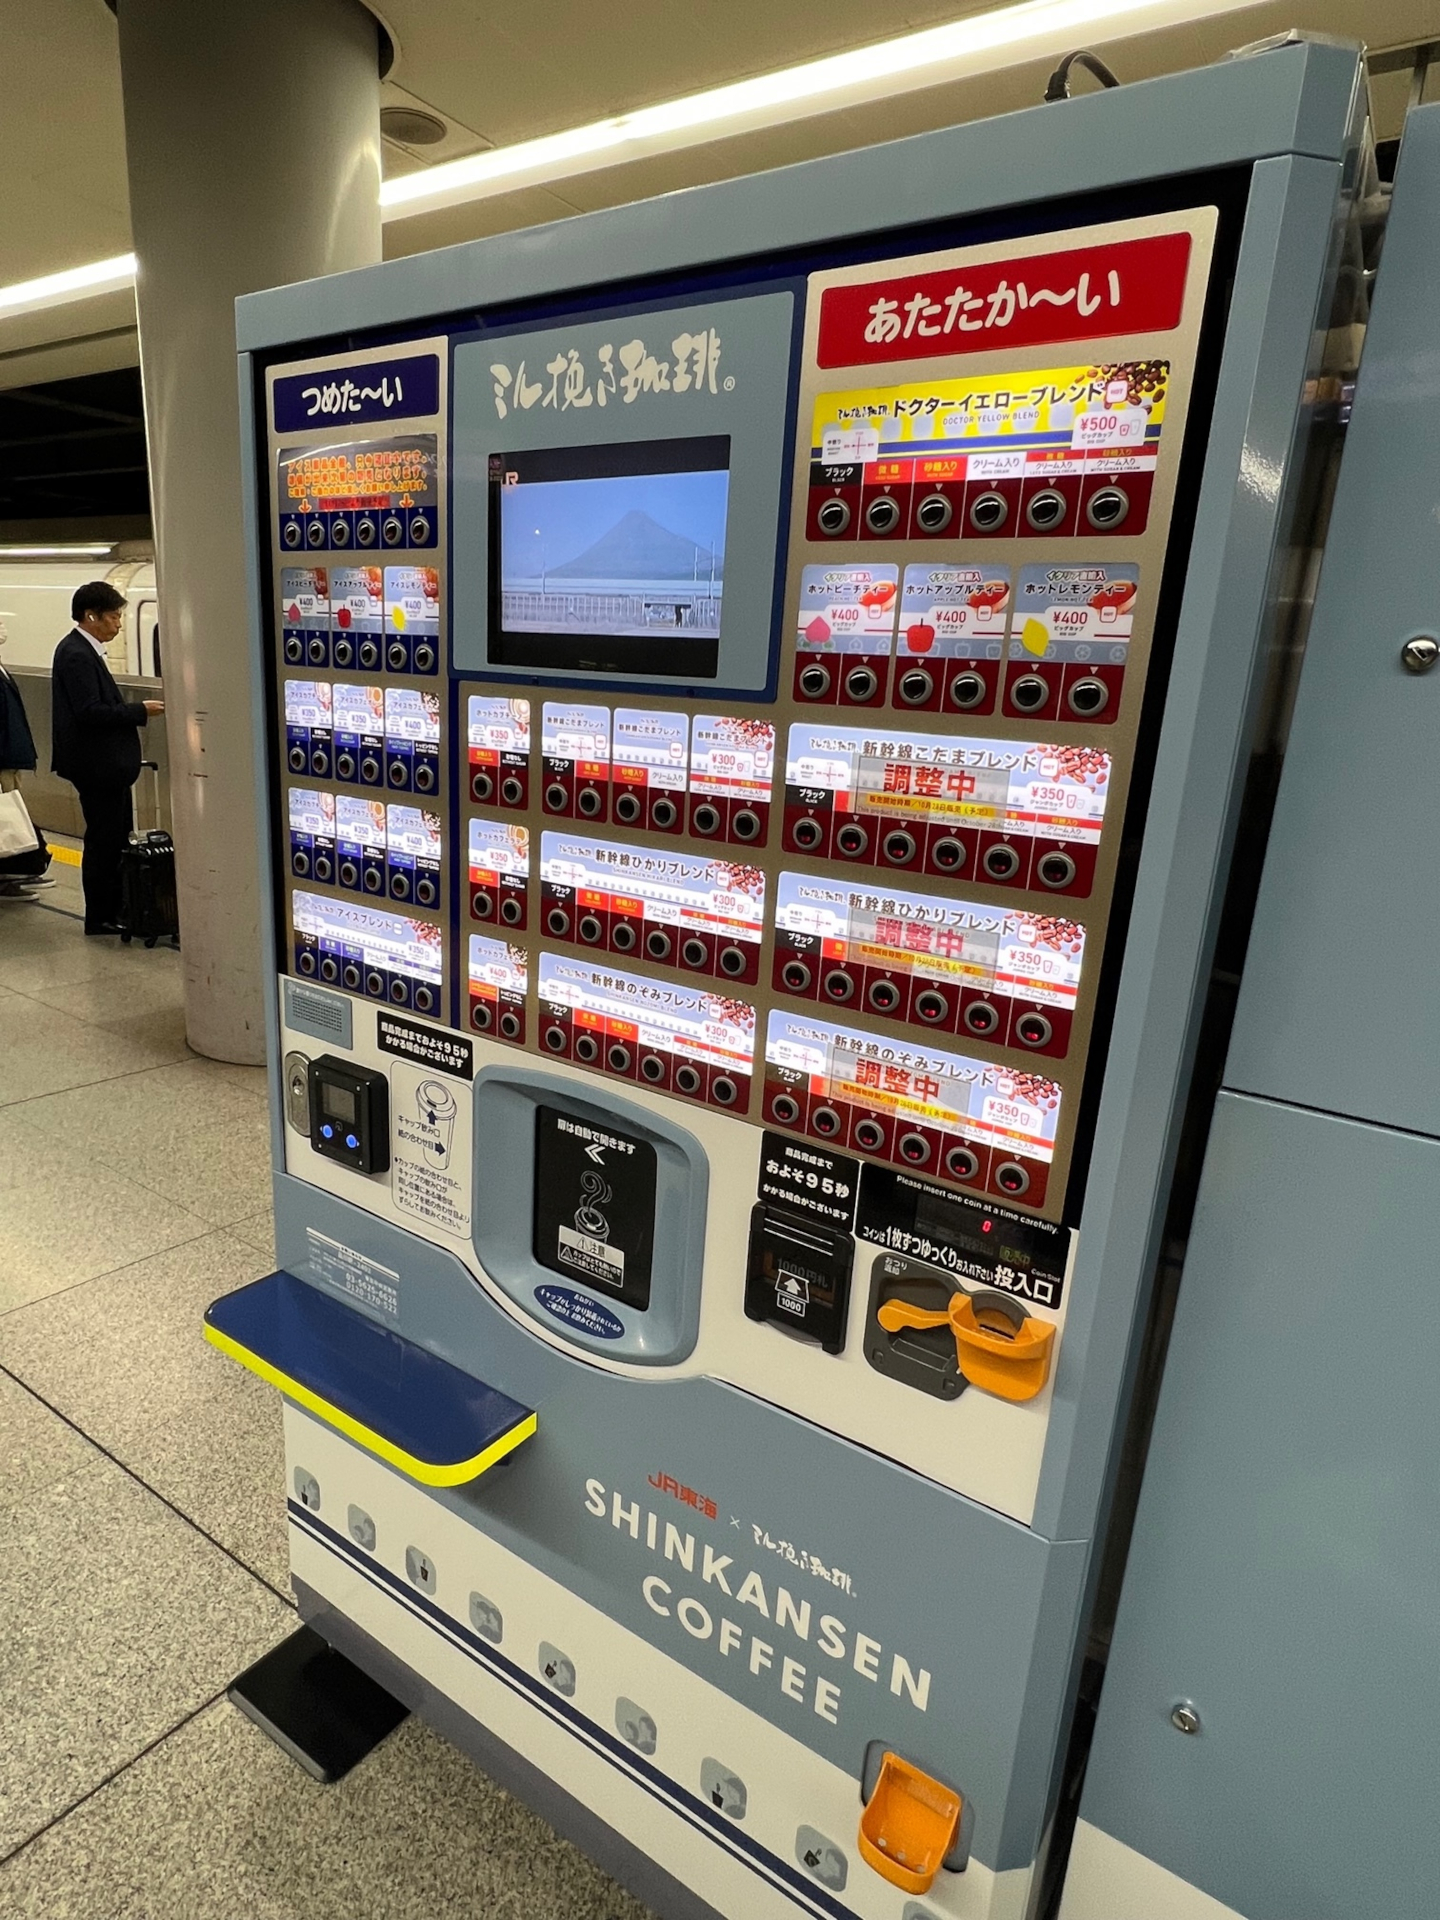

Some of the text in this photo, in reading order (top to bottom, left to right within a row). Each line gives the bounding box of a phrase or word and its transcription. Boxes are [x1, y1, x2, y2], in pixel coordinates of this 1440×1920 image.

[863, 269, 1120, 345] あたたか〜い
[301, 376, 403, 416] つめた〜い
[893, 380, 1106, 419] ドクターイエローブレンド
[943, 410, 1040, 426] DOCTOR YELLOW BLEND
[1080, 415, 1117, 431] ¥500
[923, 460, 958, 472] 砂糖入り
[972, 456, 1020, 470] クリーム入り
[1035, 461, 1073, 470] クリーム入り
[1096, 458, 1136, 467] クリーム入り
[825, 466, 854, 478] ブラック
[808, 584, 888, 595] ホットピーチティー
[905, 584, 1005, 595] ホットアップルティー
[1025, 583, 1126, 595] ホットレモンティー
[299, 597, 314, 606] ¥400
[350, 599, 366, 608] ¥400
[405, 600, 422, 610] ¥400
[831, 608, 859, 621] ¥400
[935, 610, 967, 624] ¥400
[1052, 610, 1088, 625] ¥400
[490, 729, 509, 741] ¥350
[548, 758, 570, 768] ブラック
[711, 753, 736, 766] ¥300
[862, 740, 1038, 773] 新幹線こだまブレンド
[652, 771, 684, 782] クリーム入り
[883, 762, 976, 802] 調整中
[798, 788, 826, 800] ブラック
[1030, 786, 1065, 801] ¥350
[1046, 825, 1082, 836] クリーム入り
[489, 851, 508, 862] ¥350
[595, 848, 715, 882] 新幹線ひかりブレンド
[551, 884, 571, 895] ブラック
[712, 893, 736, 907] ¥300
[336, 907, 392, 929] アイスブレンド
[646, 904, 677, 917] クリーム入り
[848, 892, 1017, 936] 新幹線ひかりブレンド
[787, 932, 814, 946] ブラック
[875, 916, 964, 959] 調整中
[1009, 949, 1042, 966] ¥350
[489, 967, 507, 979] ¥400
[591, 972, 708, 1013] 新幹線のぞみブレンド
[641, 1029, 671, 1043] クリーム入り
[704, 1023, 728, 1038] ¥300
[834, 1033, 995, 1087] 新幹線のぞみブレンド
[777, 1066, 803, 1080] ブラック
[855, 1056, 940, 1103] 調整中
[988, 1099, 1019, 1118] ¥350
[397, 1128, 435, 1150] 紙の合わせ目
[557, 1118, 637, 1155] 扉は自動で開きます
[784, 1146, 834, 1170] 商品完成まで
[765, 1159, 850, 1199] およそ95秒
[762, 1183, 849, 1221] かかる場合がございます
[896, 1175, 1059, 1235] Please insert one coin at a time carefully.
[589, 1240, 607, 1259] 注意
[885, 1256, 908, 1271] おつり
[1031, 1268, 1047, 1279] Coin
[994, 1265, 1054, 1305] 投入口
[781, 1297, 801, 1312] 1000
[646, 1470, 719, 1521] JR東海
[584, 1478, 932, 1713] SHINKANSEN
[642, 1575, 842, 1725] COFFEE
